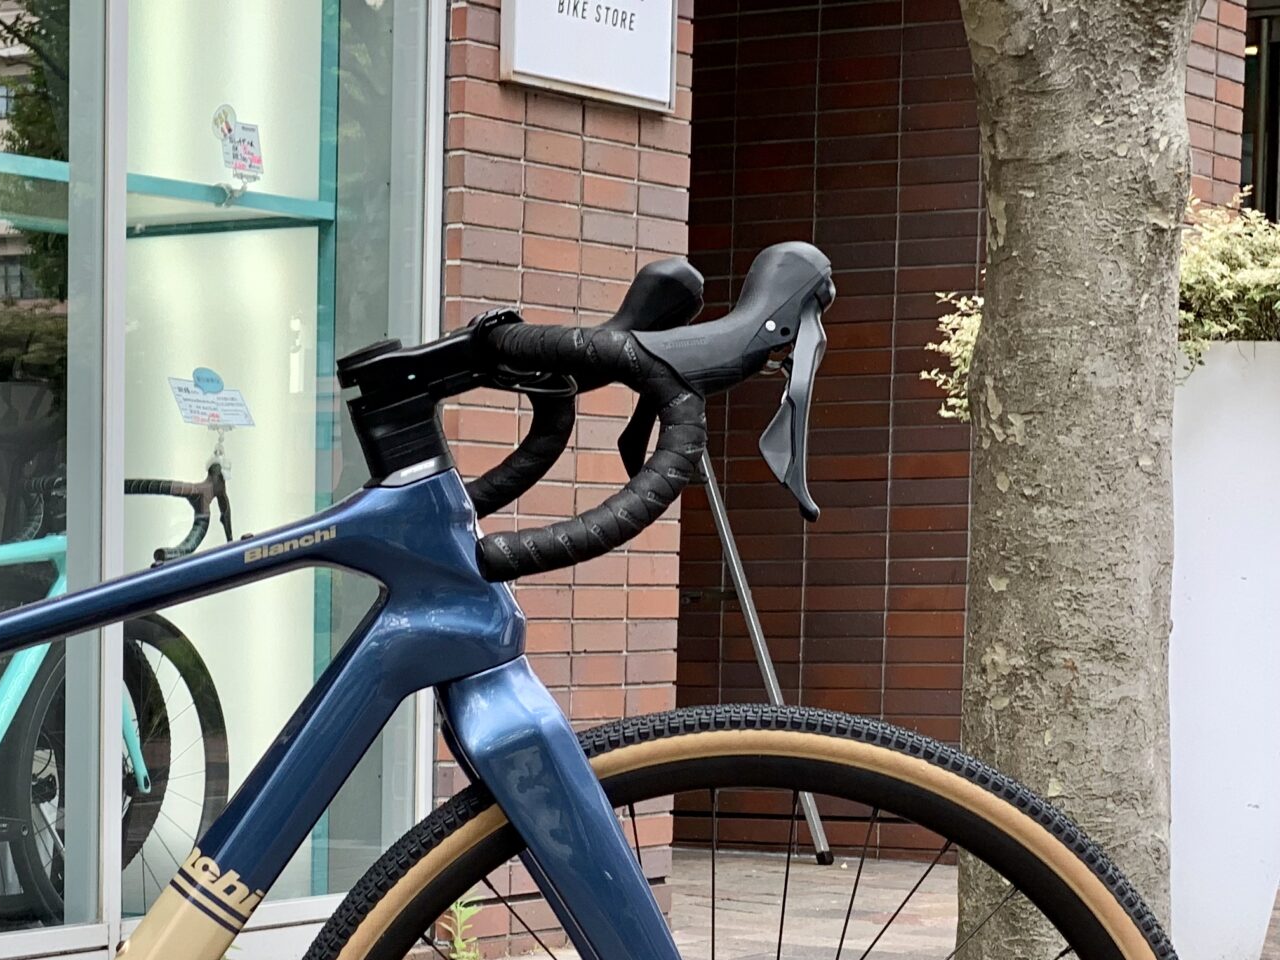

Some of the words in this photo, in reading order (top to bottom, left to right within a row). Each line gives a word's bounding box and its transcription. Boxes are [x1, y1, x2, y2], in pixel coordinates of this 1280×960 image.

[557, 0, 588, 20] BIKE
[594, 4, 636, 32] STORE
[244, 525, 337, 564] Bianchi
